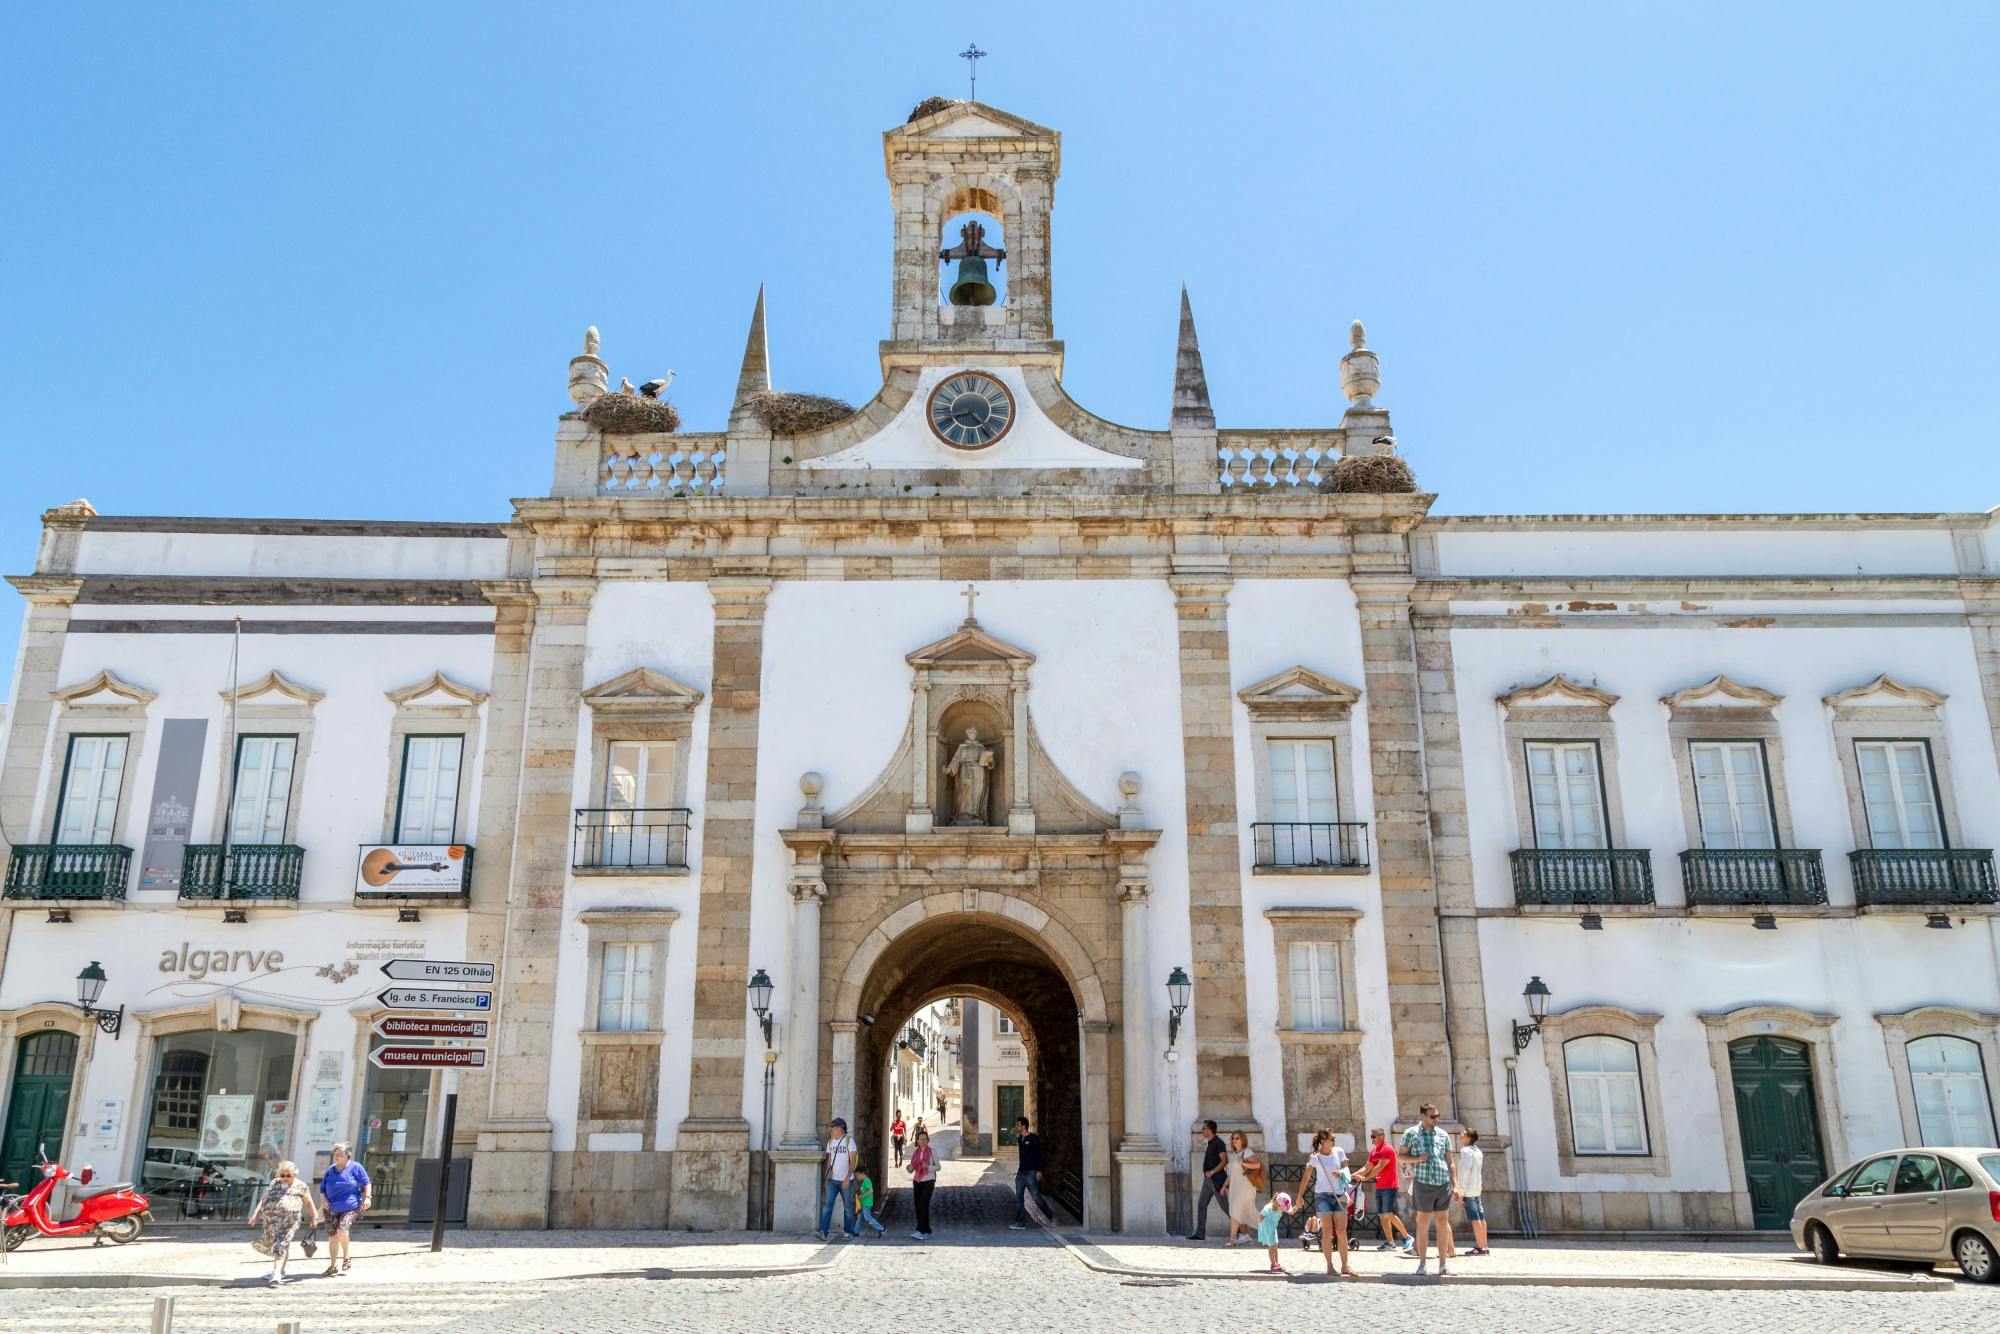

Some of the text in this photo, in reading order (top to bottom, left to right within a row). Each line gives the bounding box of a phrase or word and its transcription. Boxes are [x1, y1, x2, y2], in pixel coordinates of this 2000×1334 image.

[346, 940, 425, 951] informação turística
[158, 941, 284, 980] algarve
[356, 952, 424, 960] tourist information
[425, 965, 491, 977] EN 125 Olhão
[389, 993, 476, 1004] Ig. de S. Francisco
[386, 1021, 474, 1034] biblioteca municipal
[384, 1052, 472, 1063] museu municipal
